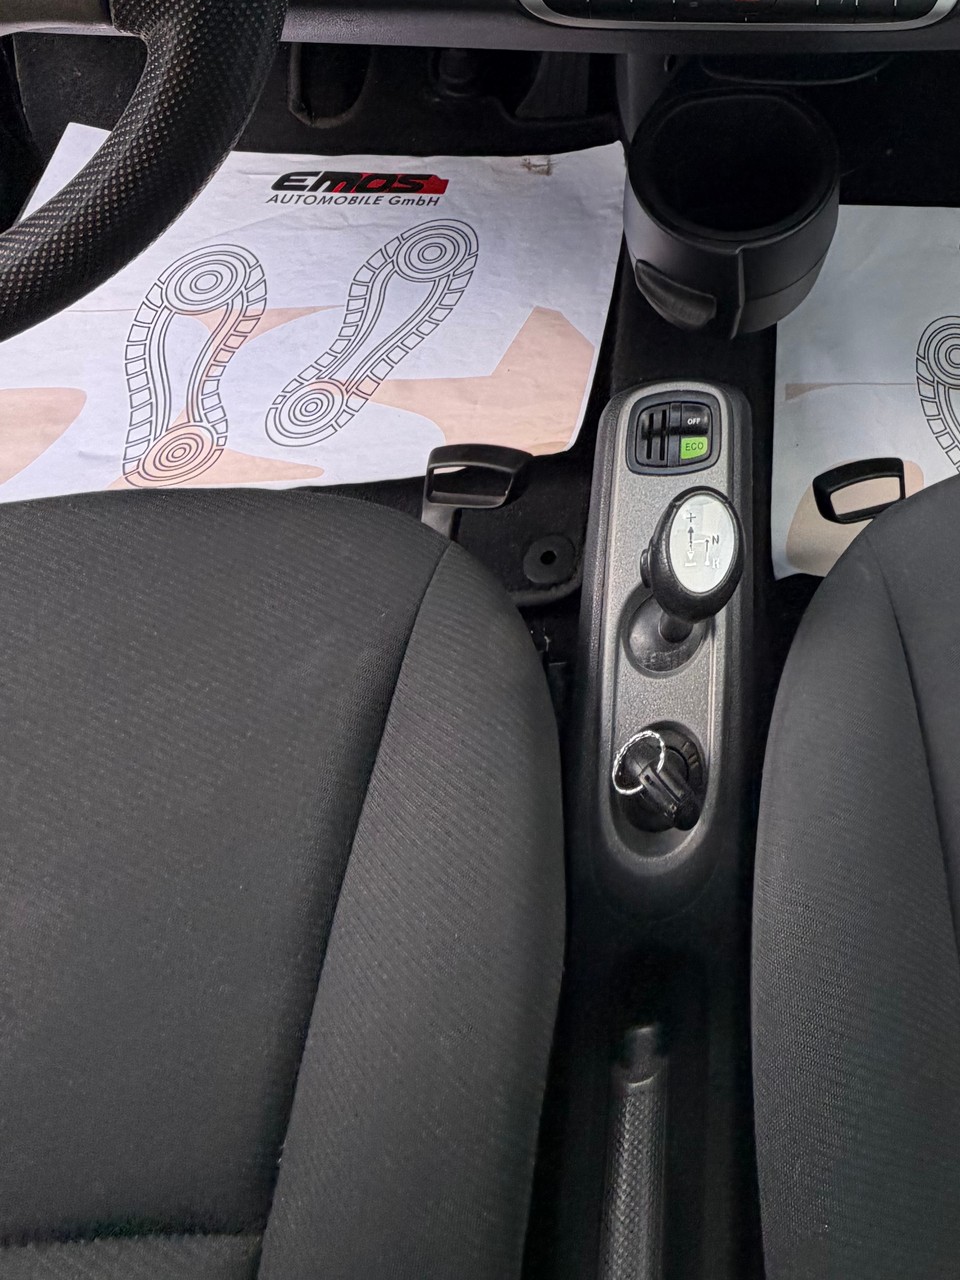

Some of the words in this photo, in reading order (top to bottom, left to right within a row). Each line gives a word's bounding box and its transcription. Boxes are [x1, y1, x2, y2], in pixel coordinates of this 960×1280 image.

[265, 193, 384, 206] AUTOMOBILE
[388, 195, 440, 207] GmbH
[687, 417, 701, 426] OFF
[685, 441, 704, 451] ECO
[711, 534, 720, 545] N
